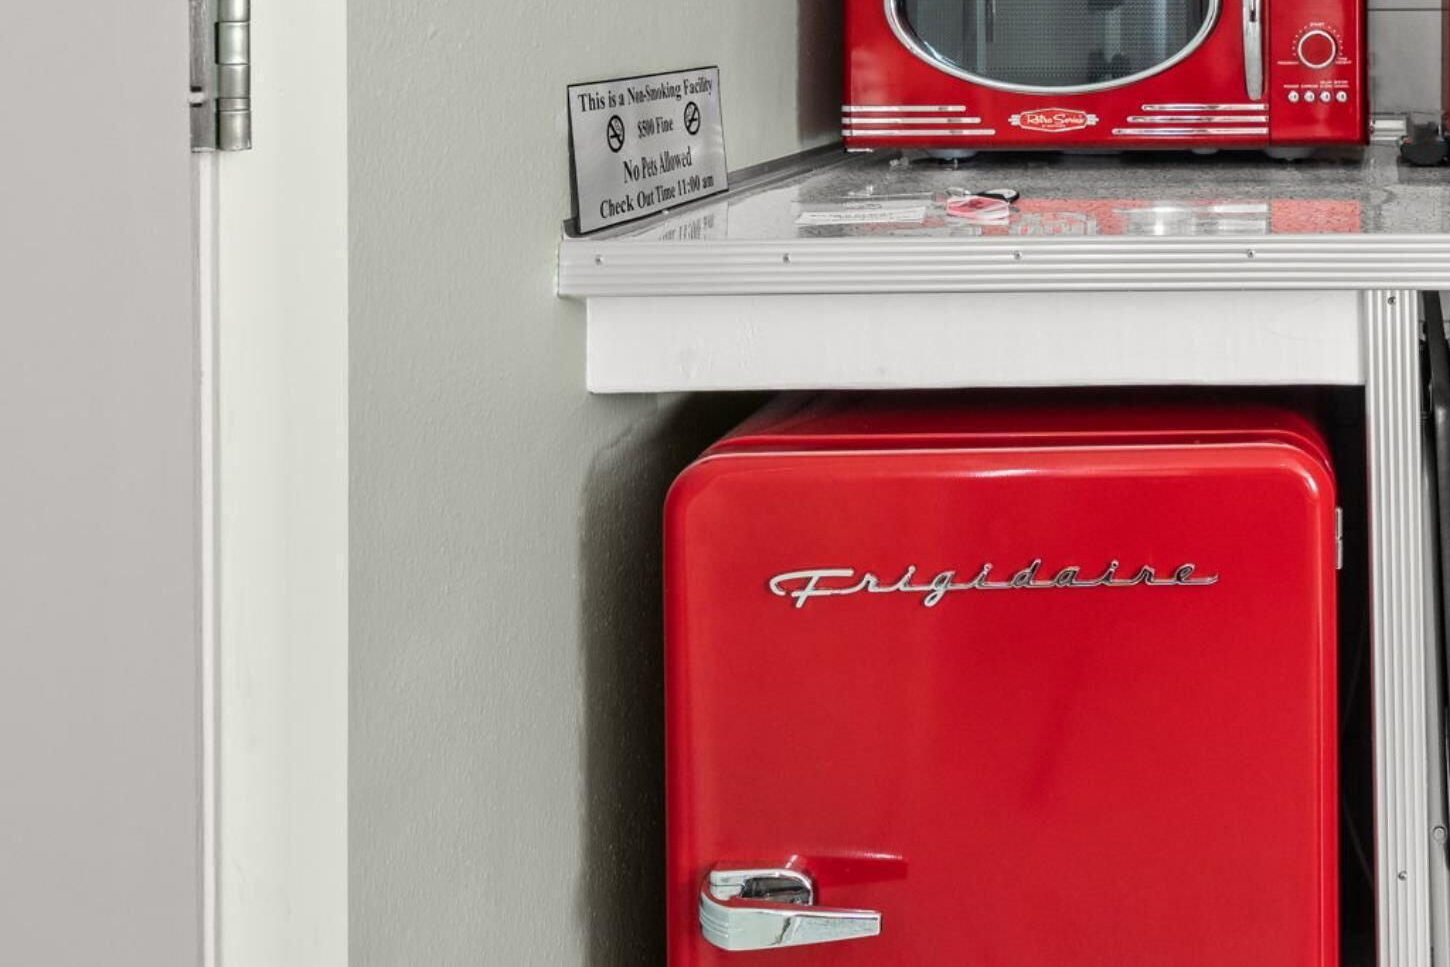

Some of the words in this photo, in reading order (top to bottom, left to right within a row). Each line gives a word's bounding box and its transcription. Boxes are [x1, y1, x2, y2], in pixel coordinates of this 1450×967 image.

[578, 92, 605, 112] This
[608, 90, 617, 108] is
[618, 95, 625, 106] a
[683, 77, 713, 96] Facility
[655, 117, 674, 133] Fine
[623, 160, 640, 184] No
[641, 156, 658, 179] Pets
[659, 146, 692, 173] Allowed
[600, 195, 634, 219] Check
[636, 191, 655, 209] Out
[656, 185, 676, 203] Time
[677, 178, 700, 197] 11:00
[702, 175, 714, 188] am
[769, 559, 1218, 608] Frigidaire
